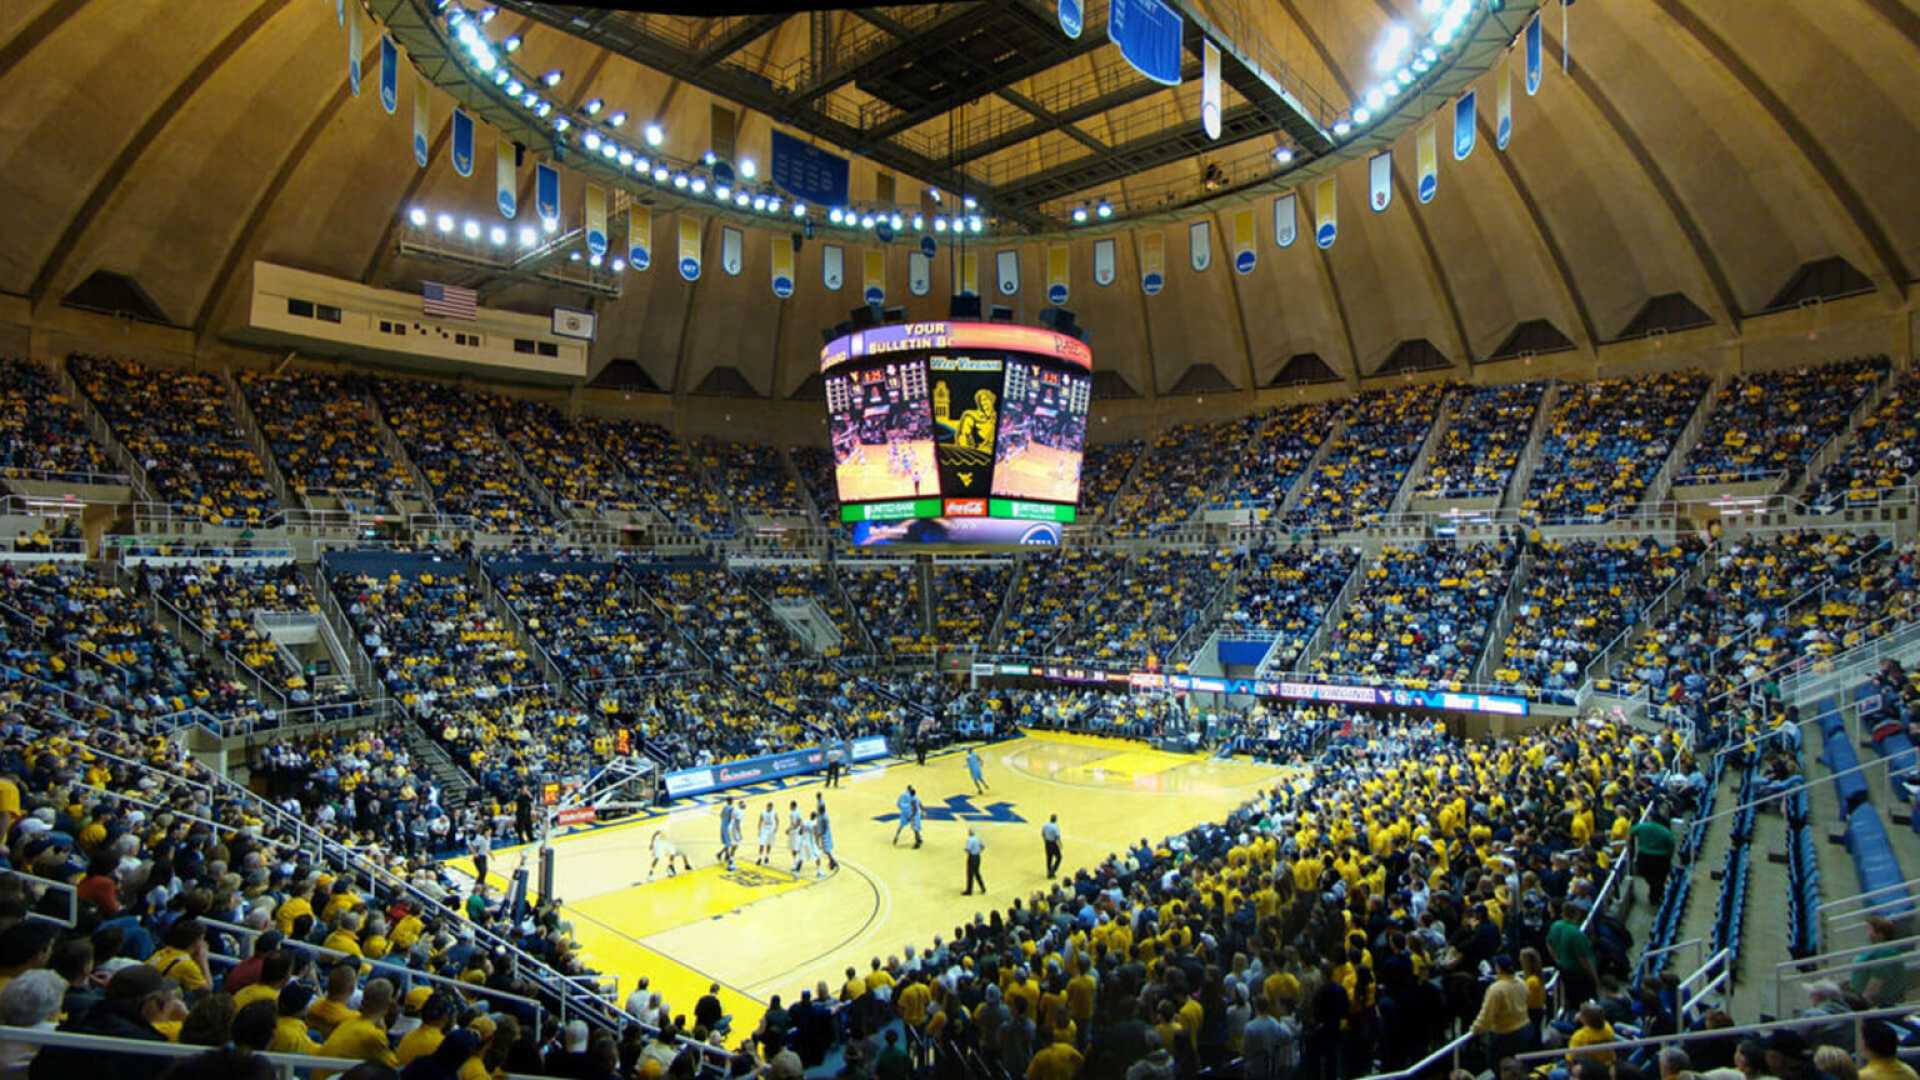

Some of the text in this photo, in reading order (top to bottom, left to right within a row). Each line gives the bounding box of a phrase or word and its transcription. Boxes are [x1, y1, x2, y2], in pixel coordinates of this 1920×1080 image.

[905, 323, 945, 335] YOUR
[868, 338, 931, 355] BULLETIN
[1320, 686, 1374, 700] VIRGINIA
